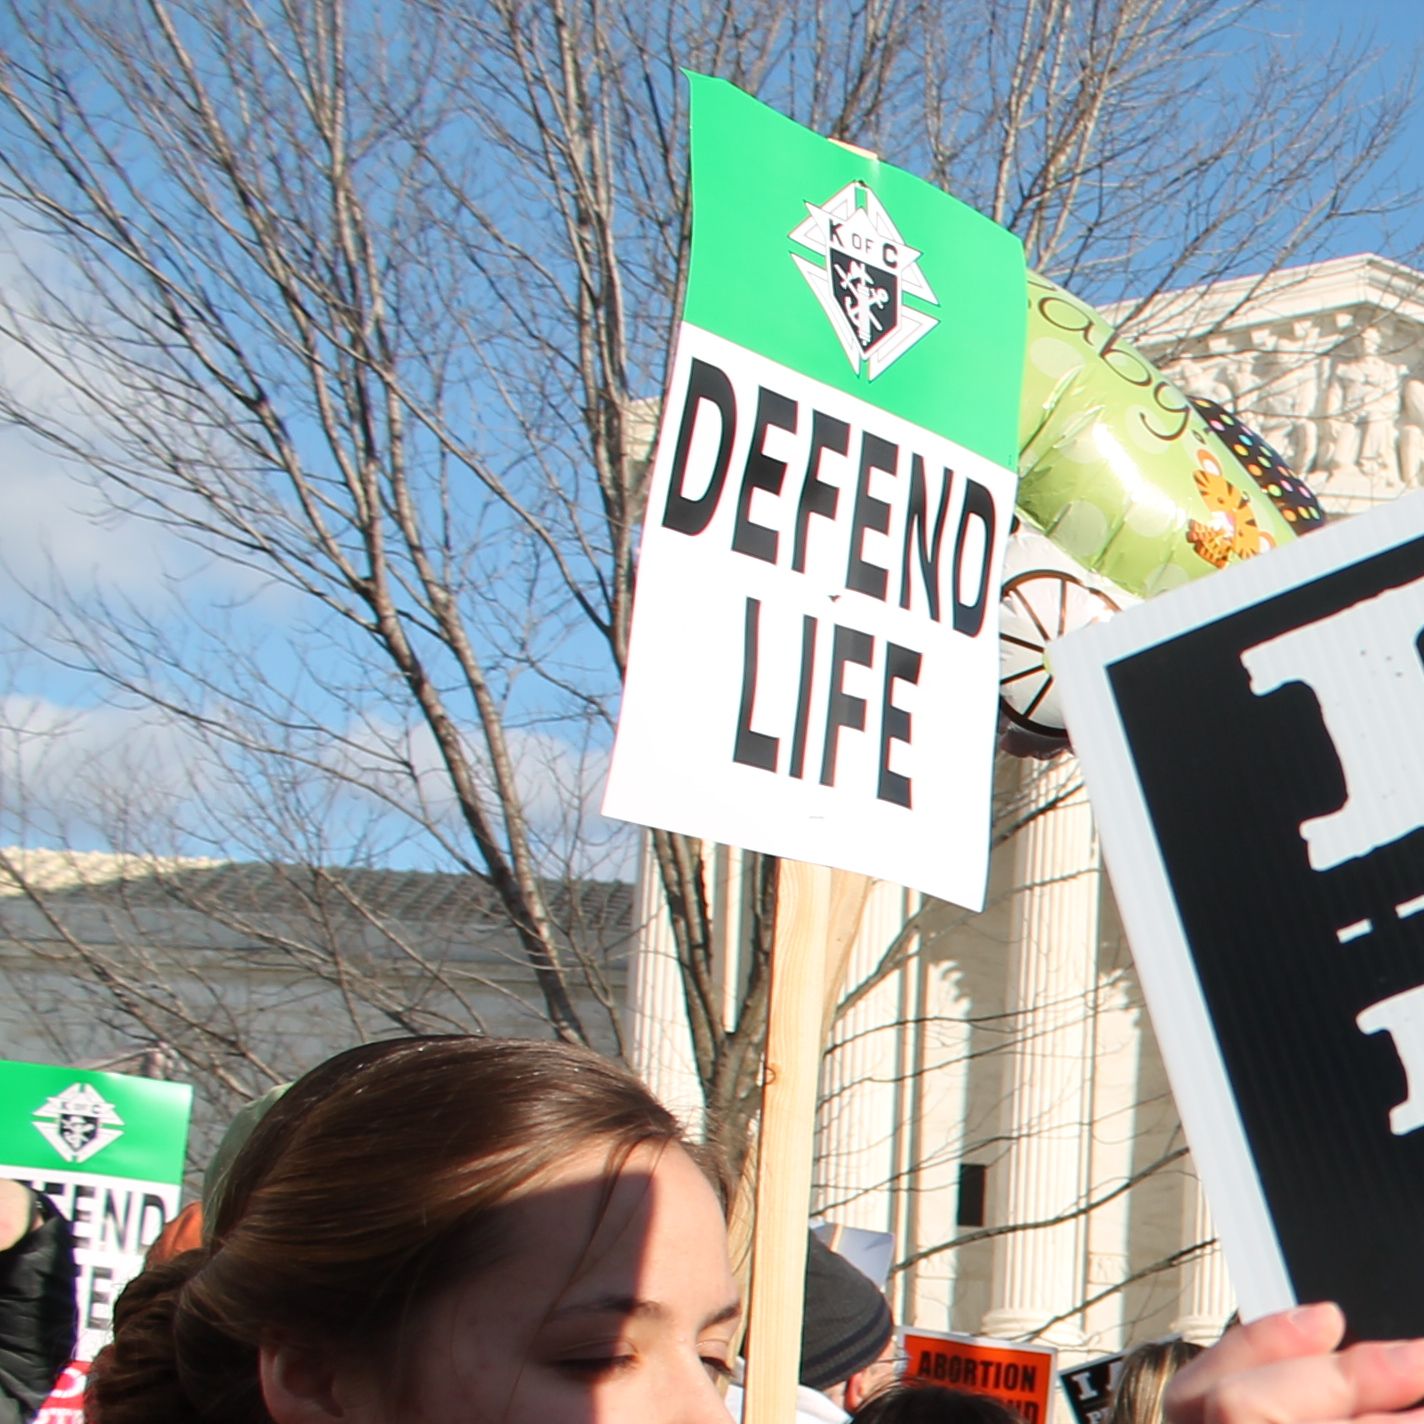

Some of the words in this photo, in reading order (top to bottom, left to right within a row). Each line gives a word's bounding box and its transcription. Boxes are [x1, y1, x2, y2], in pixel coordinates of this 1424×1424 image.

[828, 216, 844, 248] K
[852, 232, 874, 254] OF
[881, 242, 899, 270] C
[660, 356, 997, 639] DEFEND
[732, 596, 923, 810] LIFE
[917, 1350, 1037, 1393] ABORTION
